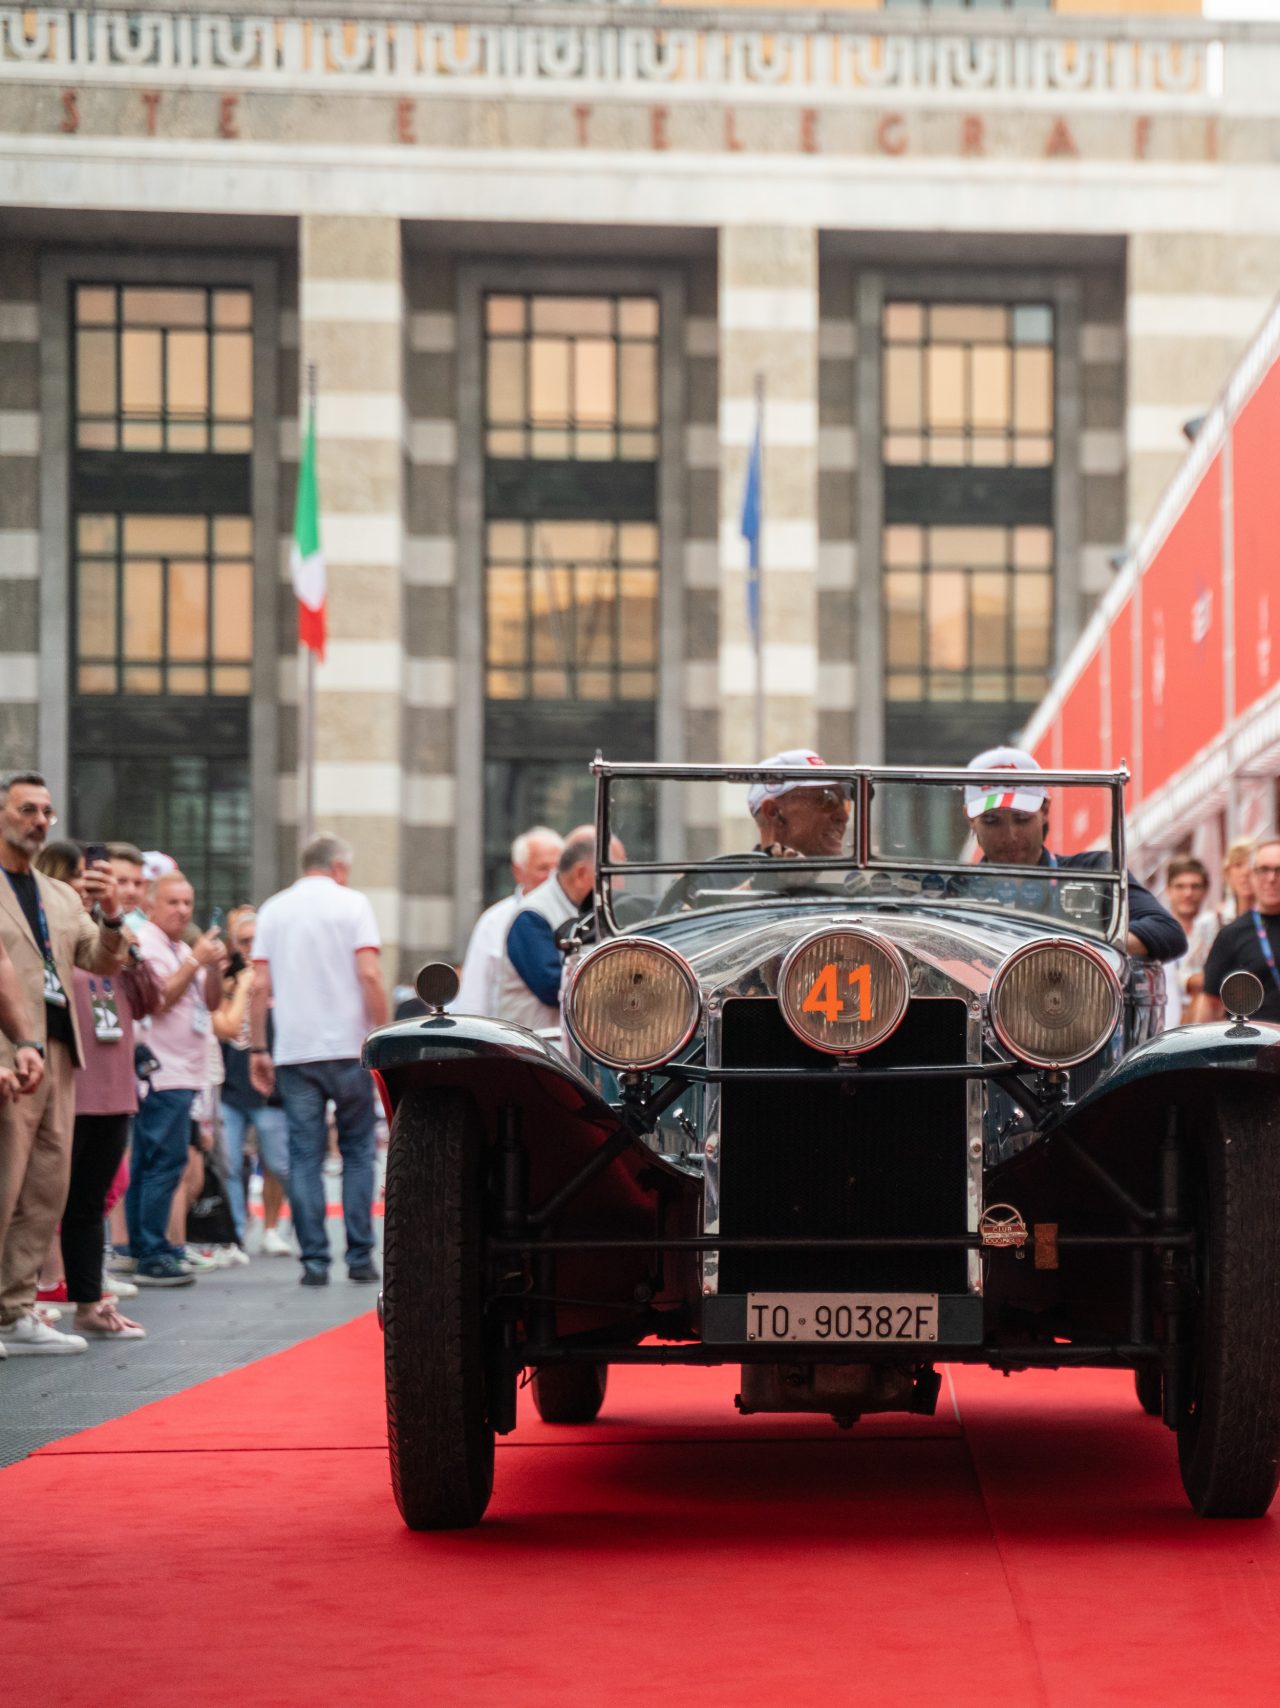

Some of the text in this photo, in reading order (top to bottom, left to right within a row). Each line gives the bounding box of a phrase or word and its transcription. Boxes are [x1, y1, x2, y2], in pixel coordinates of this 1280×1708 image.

[397, 98, 417, 144] E
[572, 102, 1219, 162] TELEGRAFI
[801, 963, 873, 1022] 41
[992, 1225, 1012, 1233] CLUB
[751, 1304, 934, 1339] TO 90382F
